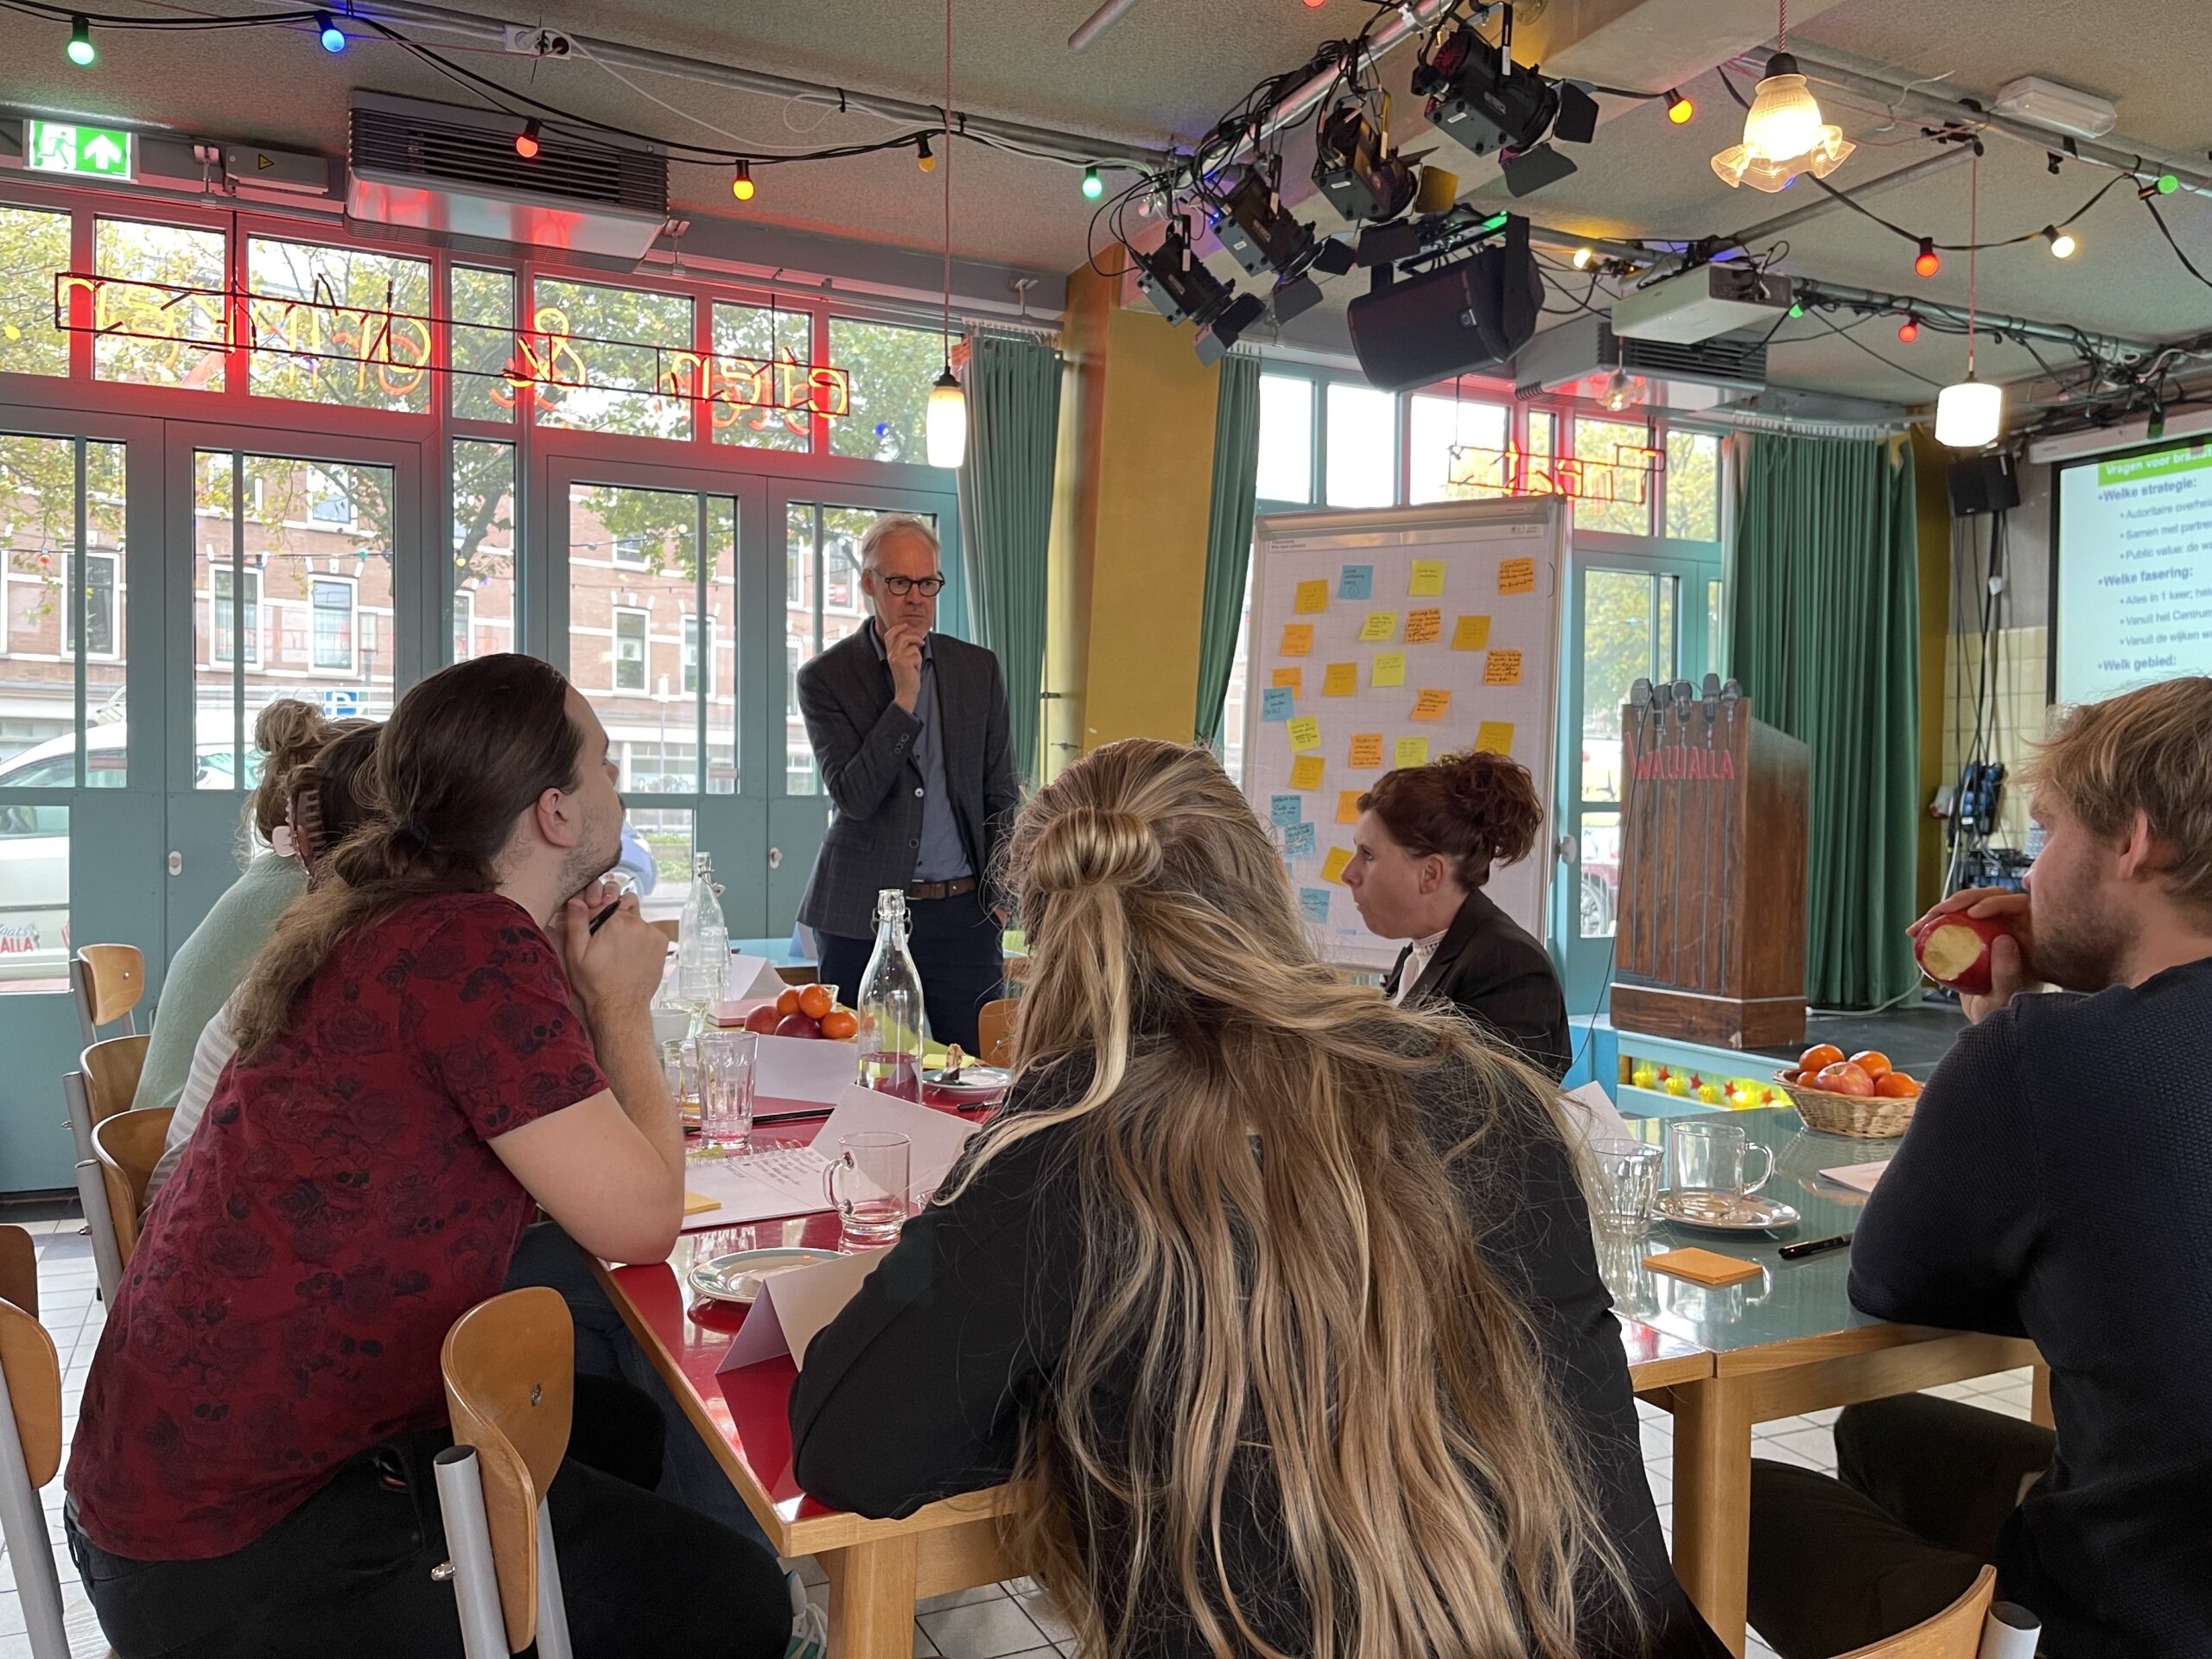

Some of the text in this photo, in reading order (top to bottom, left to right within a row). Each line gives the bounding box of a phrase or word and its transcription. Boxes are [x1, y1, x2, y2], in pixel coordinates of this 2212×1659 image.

[2145, 454, 2171, 469] voor
[2103, 478, 2197, 501] Welke strategie:
[2126, 548, 2154, 560] Public
[2187, 543, 2199, 553] de
[2103, 567, 2193, 587] Welke fasering:
[2126, 612, 2154, 625] Vanuit
[2126, 632, 2154, 646] Vanuit
[2103, 653, 2177, 672] Welk gebied:
